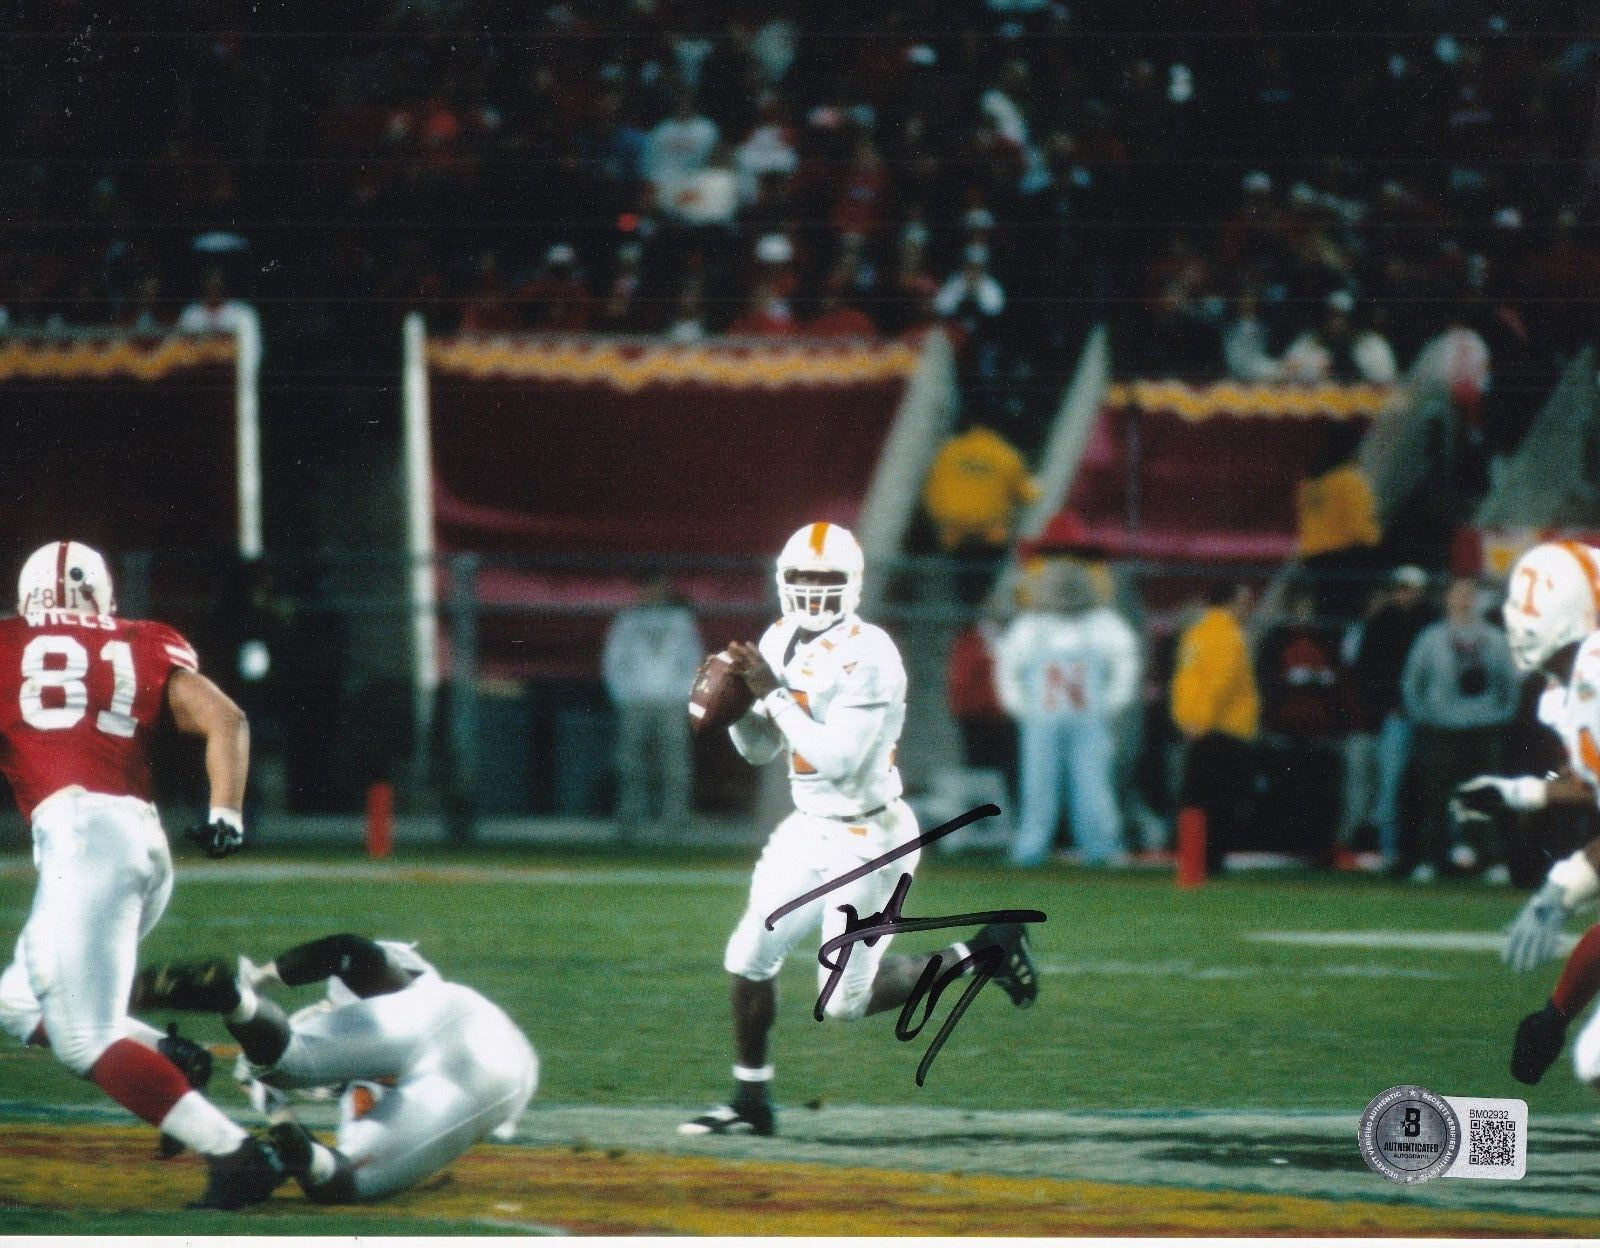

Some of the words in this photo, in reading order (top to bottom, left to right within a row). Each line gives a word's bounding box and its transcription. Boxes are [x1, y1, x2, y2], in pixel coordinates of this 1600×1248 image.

[19, 635, 139, 738] 81
[1365, 1121, 1375, 1156] VERIFIED
[1370, 1091, 1402, 1121] AUTHENTIC
[1404, 1107, 1421, 1138] B
[1422, 1092, 1450, 1116] BECKETT
[1446, 1116, 1457, 1150] VERIFIED
[1469, 1109, 1509, 1120] BM02932
[1384, 1141, 1439, 1153] AUTHENTICATED
